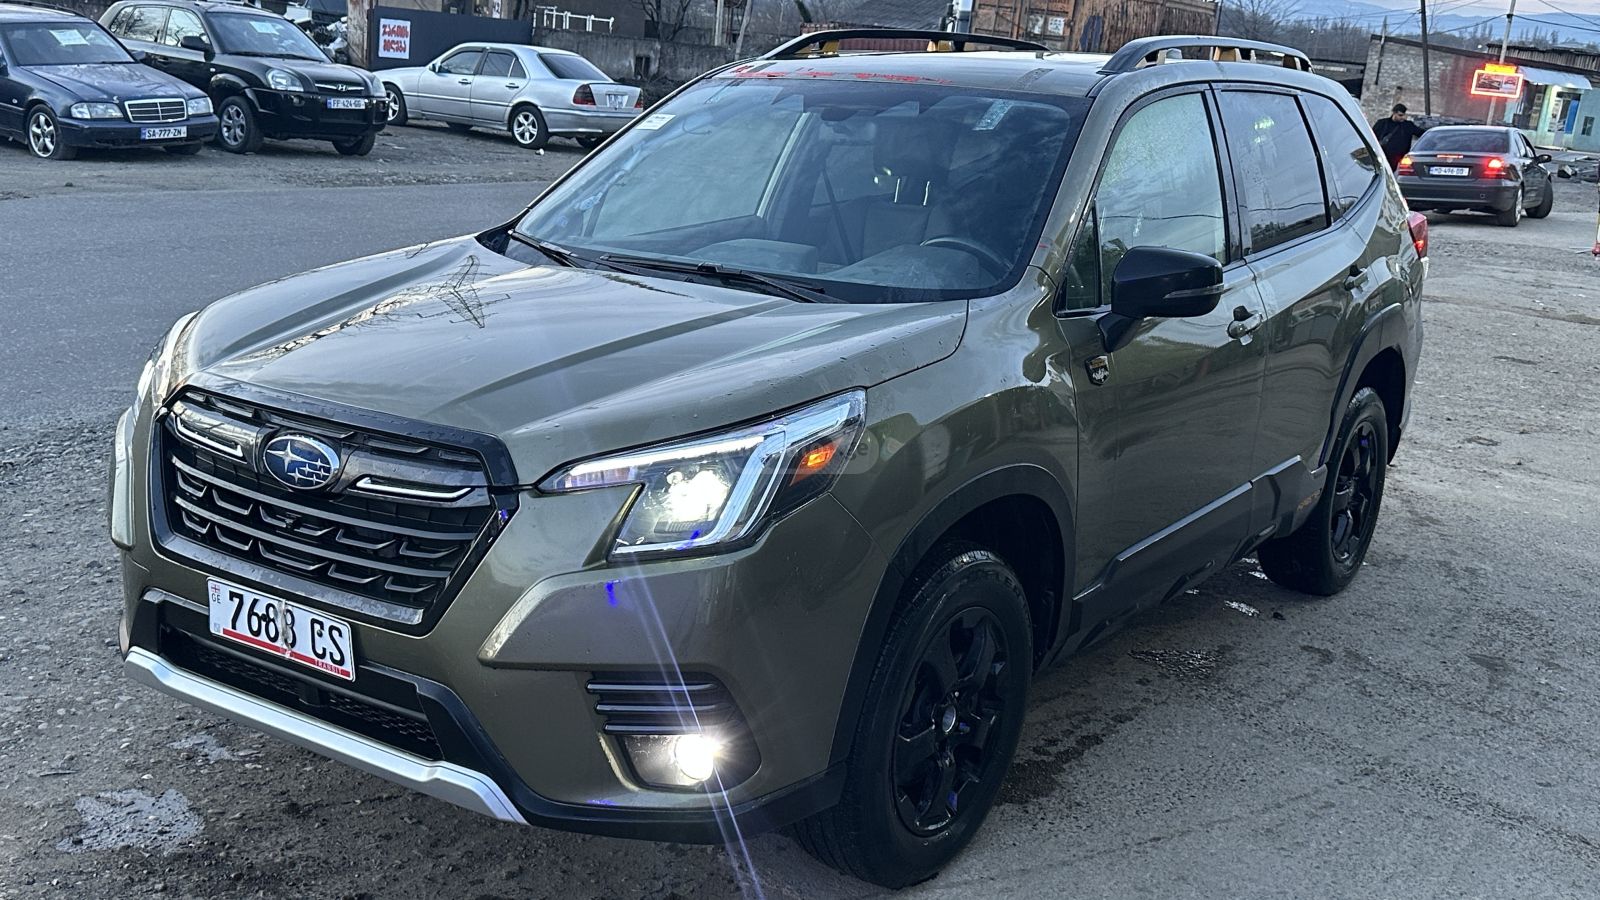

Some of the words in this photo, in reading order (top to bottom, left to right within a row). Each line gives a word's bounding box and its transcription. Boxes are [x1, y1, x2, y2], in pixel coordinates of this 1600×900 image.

[147, 128, 182, 138] SA-777-ZN
[211, 592, 221, 604] GE
[310, 617, 346, 667] CS
